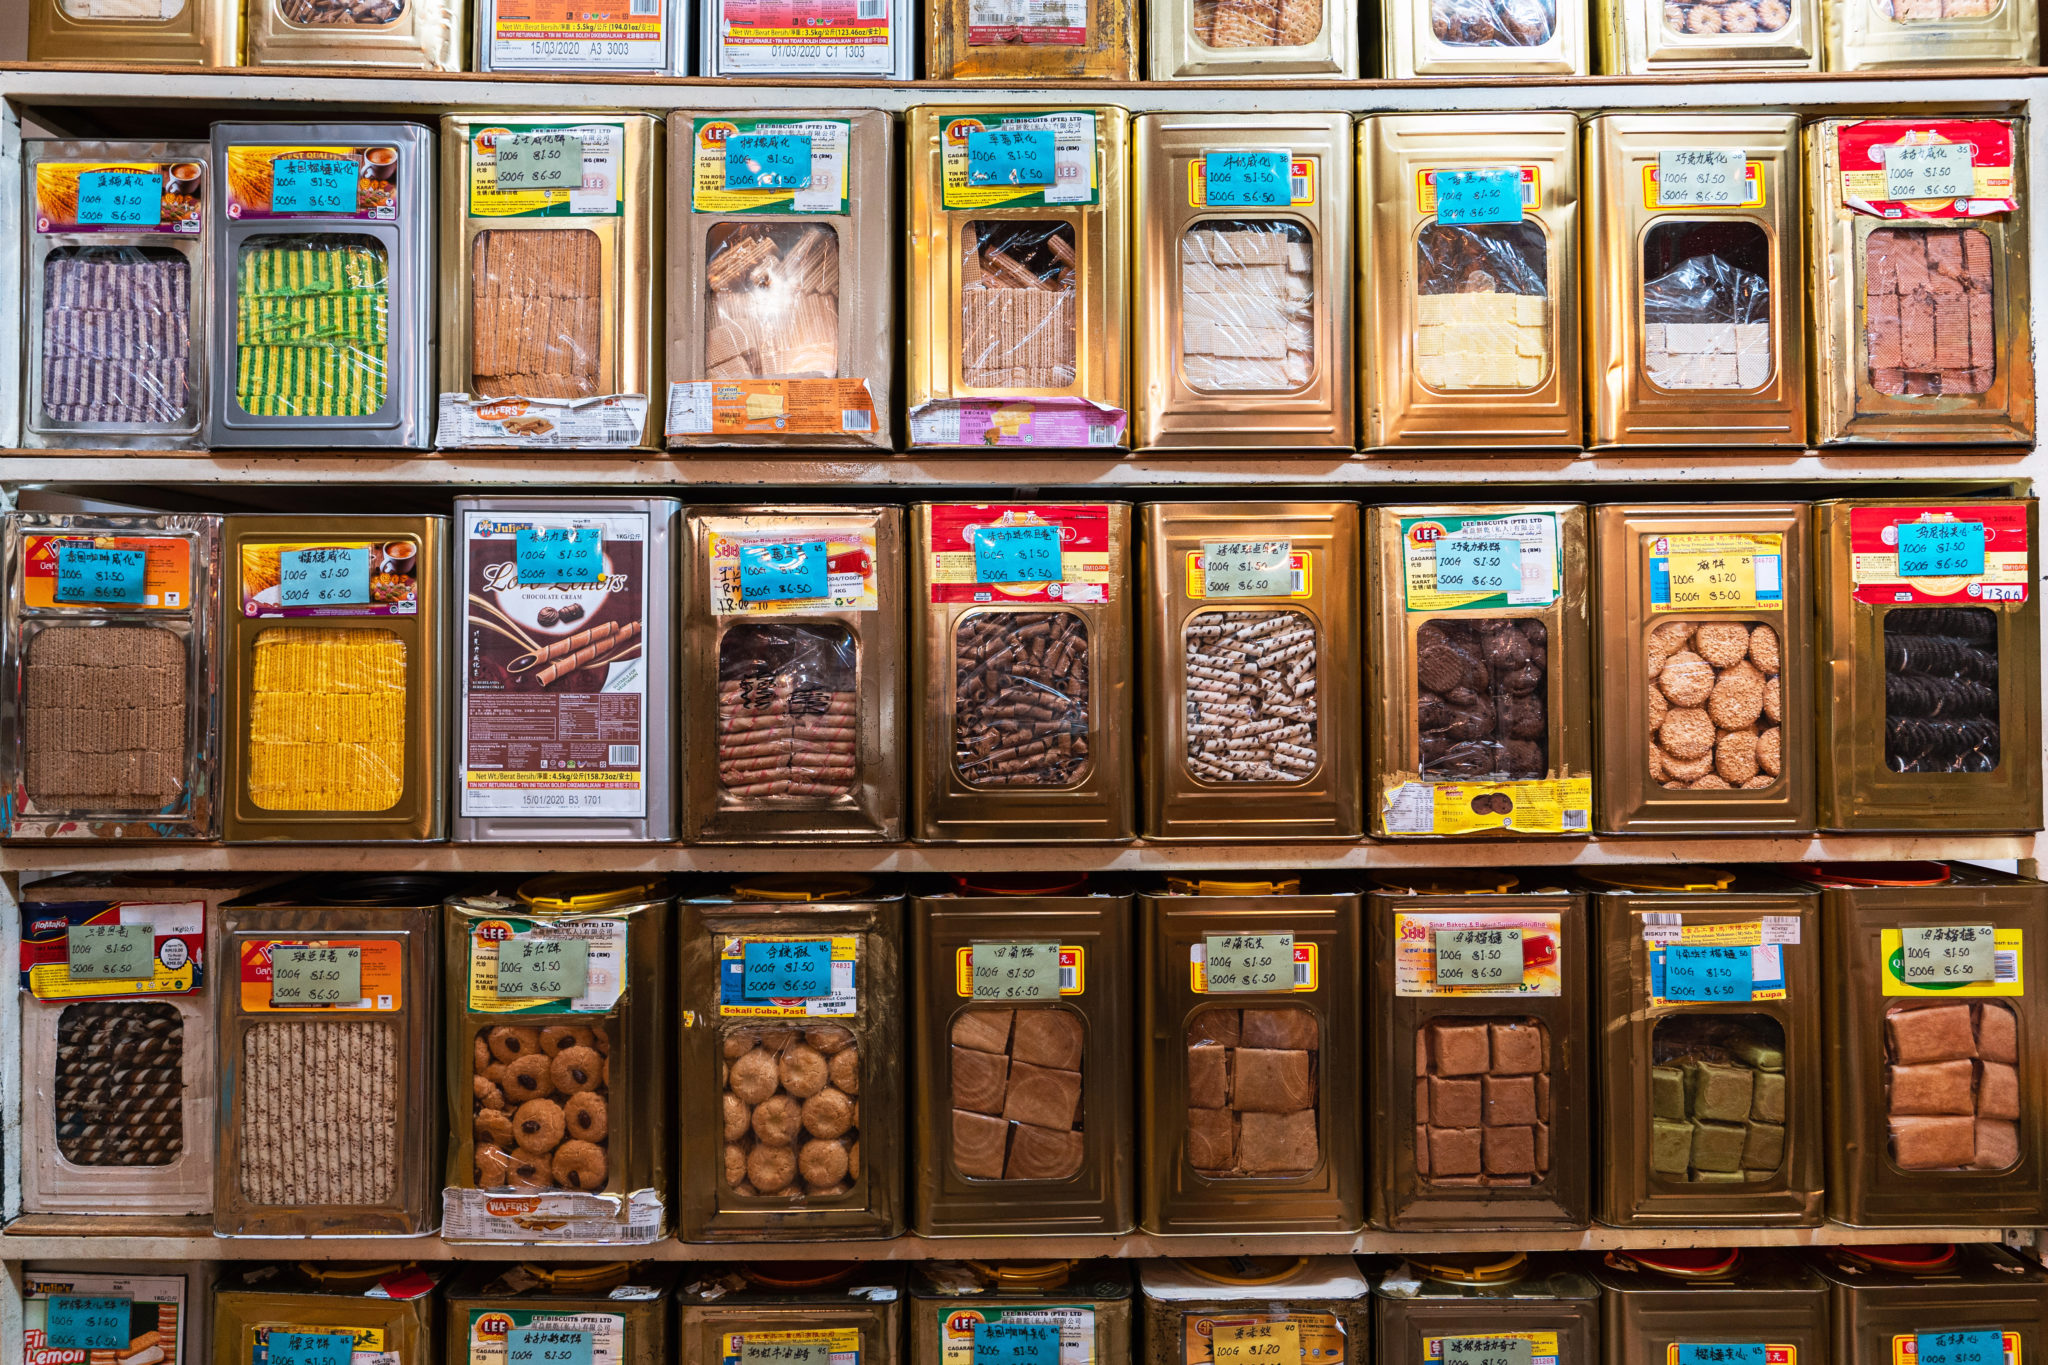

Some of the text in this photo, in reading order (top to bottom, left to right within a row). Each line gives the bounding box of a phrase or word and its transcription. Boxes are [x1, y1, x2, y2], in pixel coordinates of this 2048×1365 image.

[530, 42, 629, 55] 15/03/2020 A3 3003
[772, 46, 864, 57] 01/03/2020 C1 1303
[955, 126, 976, 137] LEE
[499, 150, 561, 161] 100G $1.50
[1210, 173, 1273, 183] 100G $1.50
[1664, 173, 1725, 184] 100G $1.50
[1442, 189, 1500, 200] 100G $1.50
[1663, 191, 1728, 201] 500G $6.50
[1891, 185, 1956, 196] 500G $6.50
[276, 196, 340, 207] 500G $6.50
[80, 211, 140, 221] 500G $6.50
[1416, 530, 1438, 540] LEE
[1903, 542, 1965, 553] 100G $1.50
[1019, 549, 1050, 559] $1.50
[61, 570, 124, 581] 100G $1.50
[283, 568, 349, 580] 100G $1.50
[520, 568, 588, 578] 500G $6.50
[1673, 573, 1736, 584] 100G $1.20
[1208, 580, 1268, 591] 500G $6.50
[1438, 575, 1502, 586] 500G $6.50
[282, 589, 352, 600] 500G $6.50
[745, 584, 812, 596] 500G $6.50
[523, 796, 601, 805] 15/01/2020 B3 1701
[483, 928, 505, 939] LEE
[72, 944, 132, 954] 100G $1.50
[1440, 950, 1501, 961] 100G $1.50
[72, 964, 132, 974] 500G $6.50
[500, 961, 560, 973] 100G $1.50
[750, 962, 814, 973] 100G $1.50
[1670, 967, 1732, 977] 100G $1.50
[1908, 965, 1973, 976] 500G $6.50
[1210, 974, 1276, 985] 500G $6.50
[747, 981, 816, 991] 500G $6.50
[1671, 986, 1734, 996] 500G $6.50
[276, 988, 340, 1000] 500G $6.50
[974, 986, 1039, 998] 500G $6.50
[490, 1202, 530, 1212] WAFERS
[36, 1282, 74, 1294] Julie's
[485, 1322, 506, 1332] LEE
[955, 1318, 976, 1329] LEE
[1217, 1344, 1280, 1356] 100G $1.20
[25, 1349, 86, 1365] Lemon
[1922, 1353, 1981, 1364] 100G $1.50
